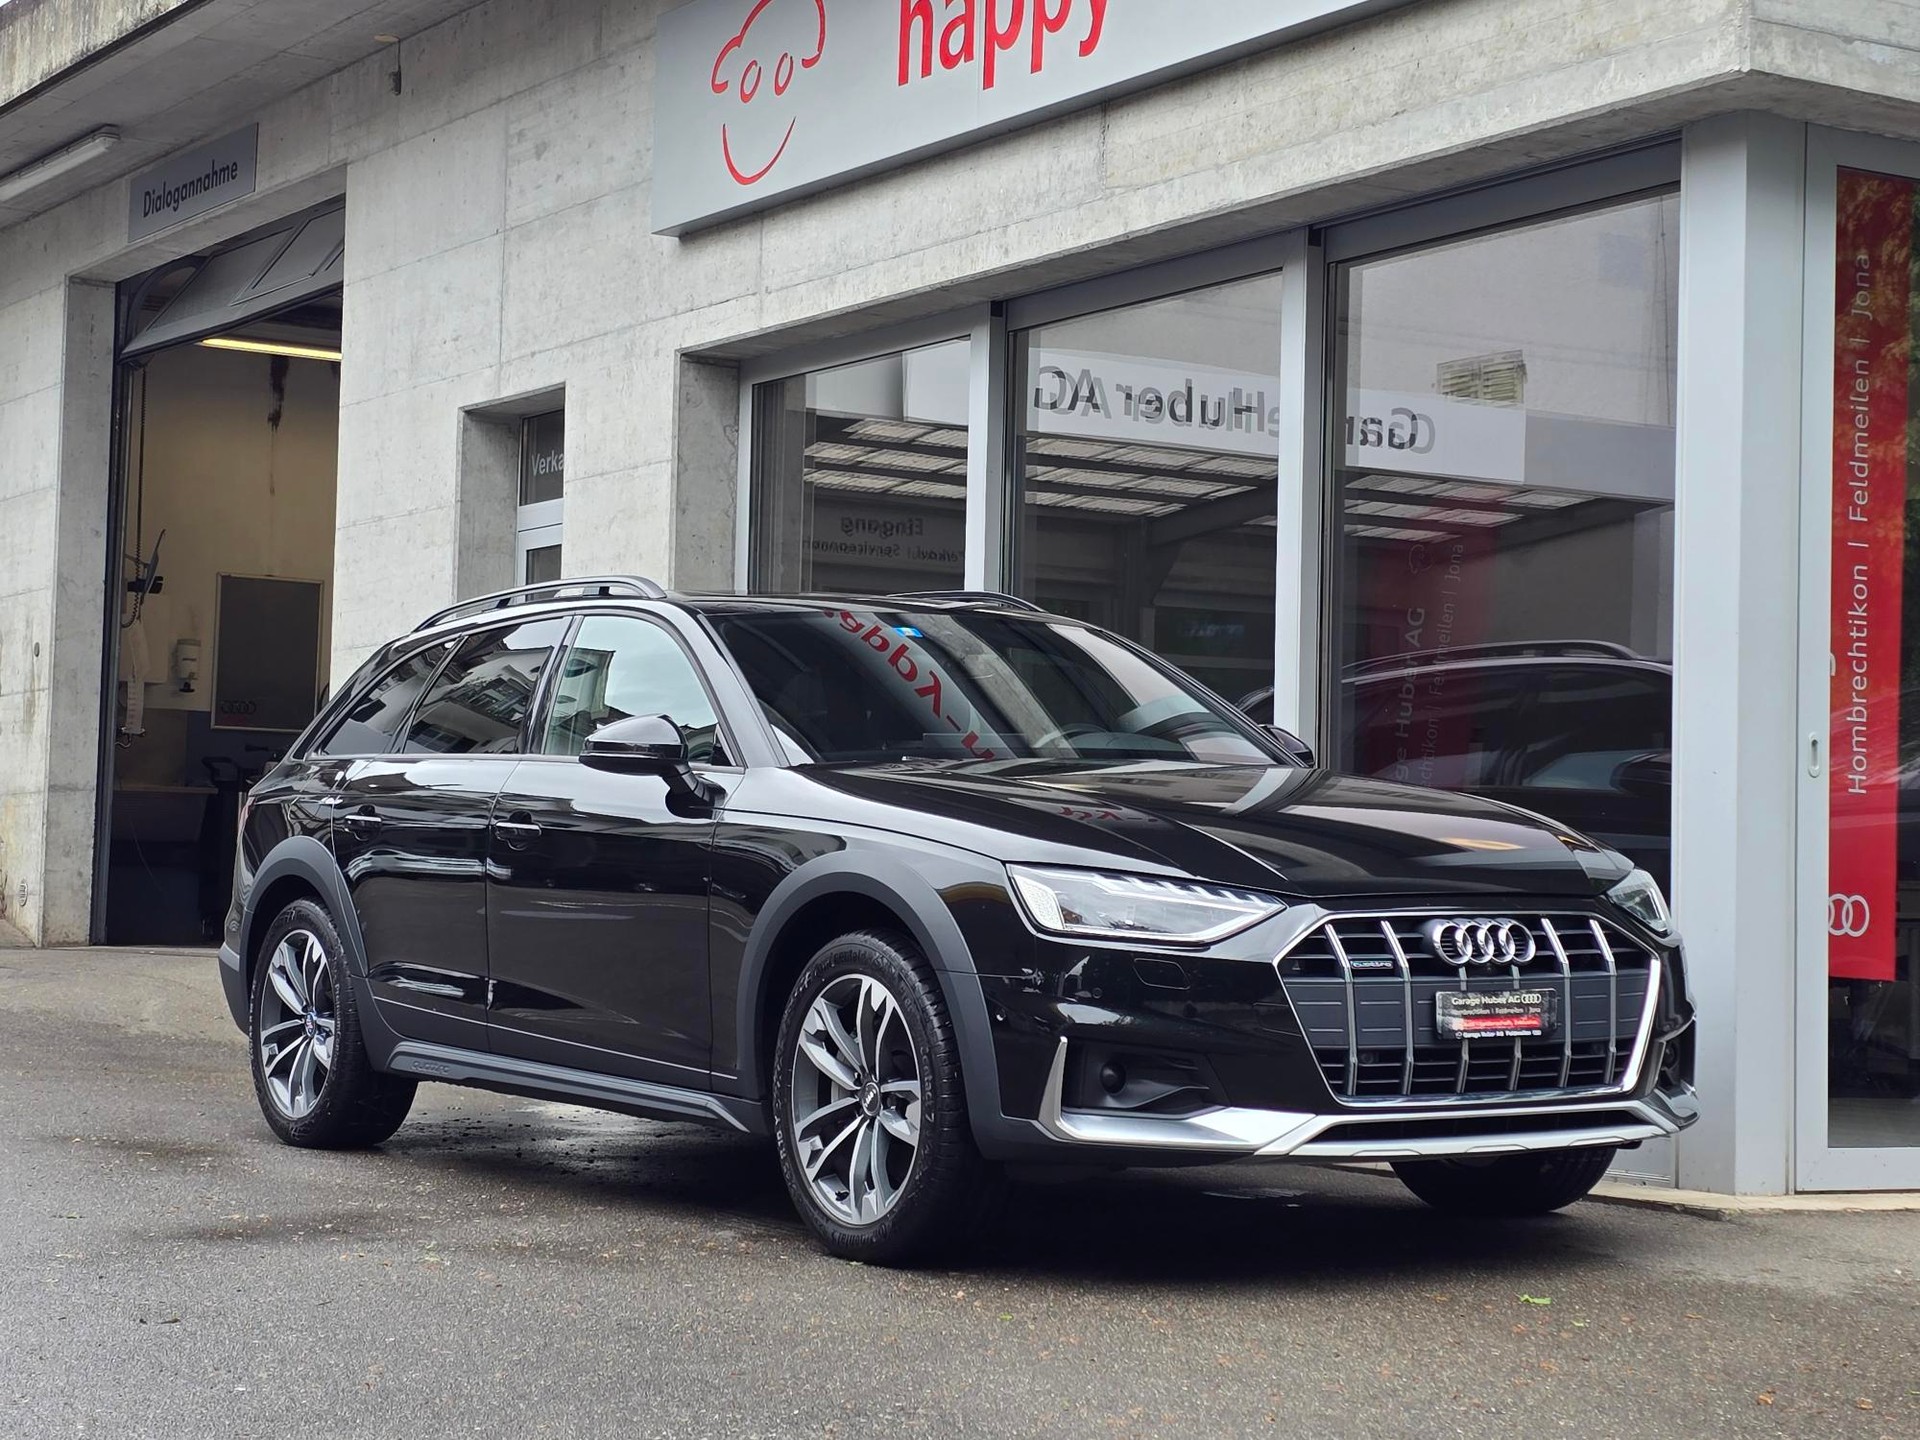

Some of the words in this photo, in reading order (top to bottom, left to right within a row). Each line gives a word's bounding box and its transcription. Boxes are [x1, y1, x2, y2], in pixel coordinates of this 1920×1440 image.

[143, 159, 239, 219] Dialogannahme
[1850, 253, 1873, 321] Jona
[1848, 359, 1871, 523] Feldmeilen
[1846, 563, 1869, 795] Hombrechtikon
